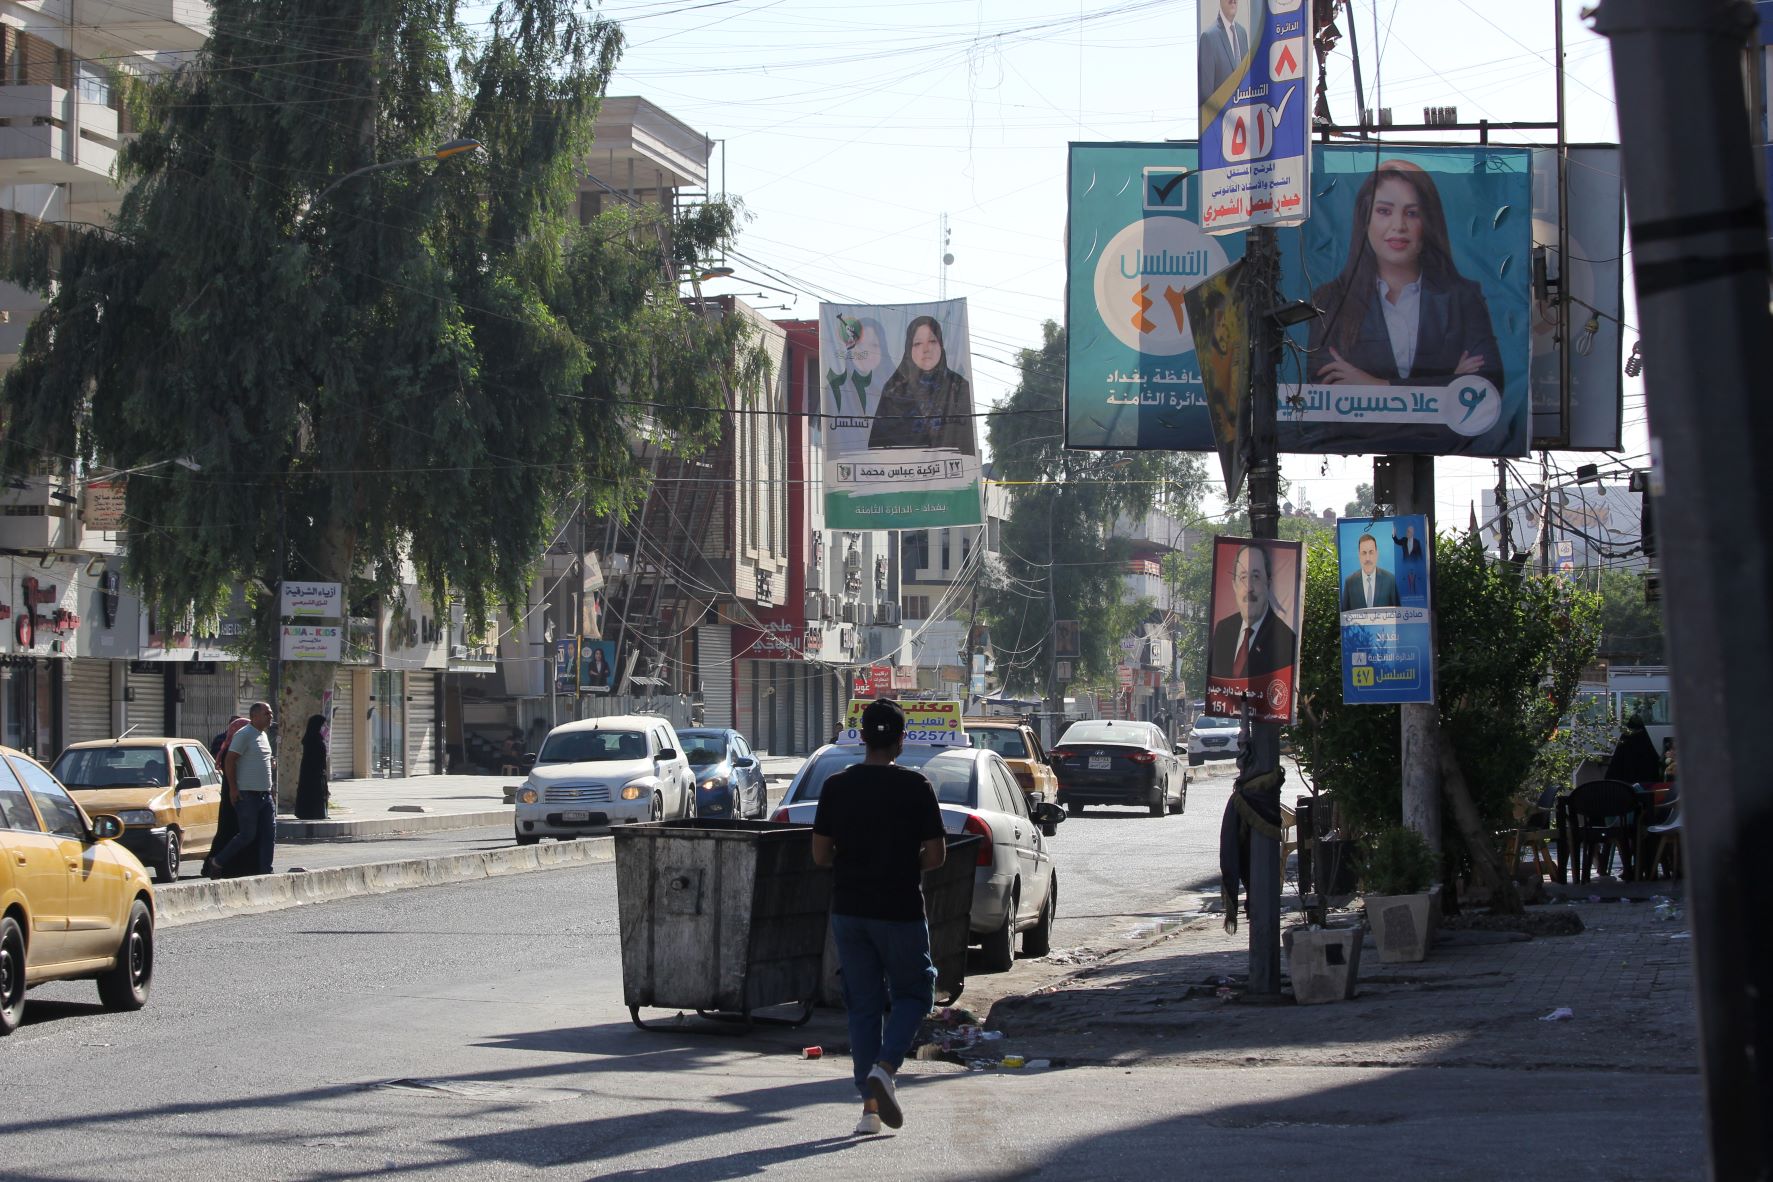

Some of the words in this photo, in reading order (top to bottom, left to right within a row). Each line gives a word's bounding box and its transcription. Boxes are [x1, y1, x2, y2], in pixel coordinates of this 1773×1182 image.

[1275, 22, 1299, 35] الدائرة
[1274, 44, 1297, 77] ٨
[1233, 84, 1268, 104] التسلسل
[1231, 108, 1265, 155] ٥١
[1246, 192, 1273, 217] فيصل
[1274, 193, 1301, 212] حيدر
[1203, 197, 1243, 226] الشمري
[1121, 249, 1208, 279] التسلسل
[1106, 369, 1147, 387] بغداد
[1152, 369, 1203, 384] حافظة
[1106, 390, 1165, 405] الثامنة
[1335, 394, 1407, 417] حسين
[860, 468, 885, 477] محمد
[888, 466, 914, 478] عباس
[917, 464, 940, 477] تركية
[1376, 668, 1415, 683] التسلسل
[901, 701, 953, 715] مكتب
[1212, 700, 1226, 713] 151
[906, 717, 945, 728] لتعليم
